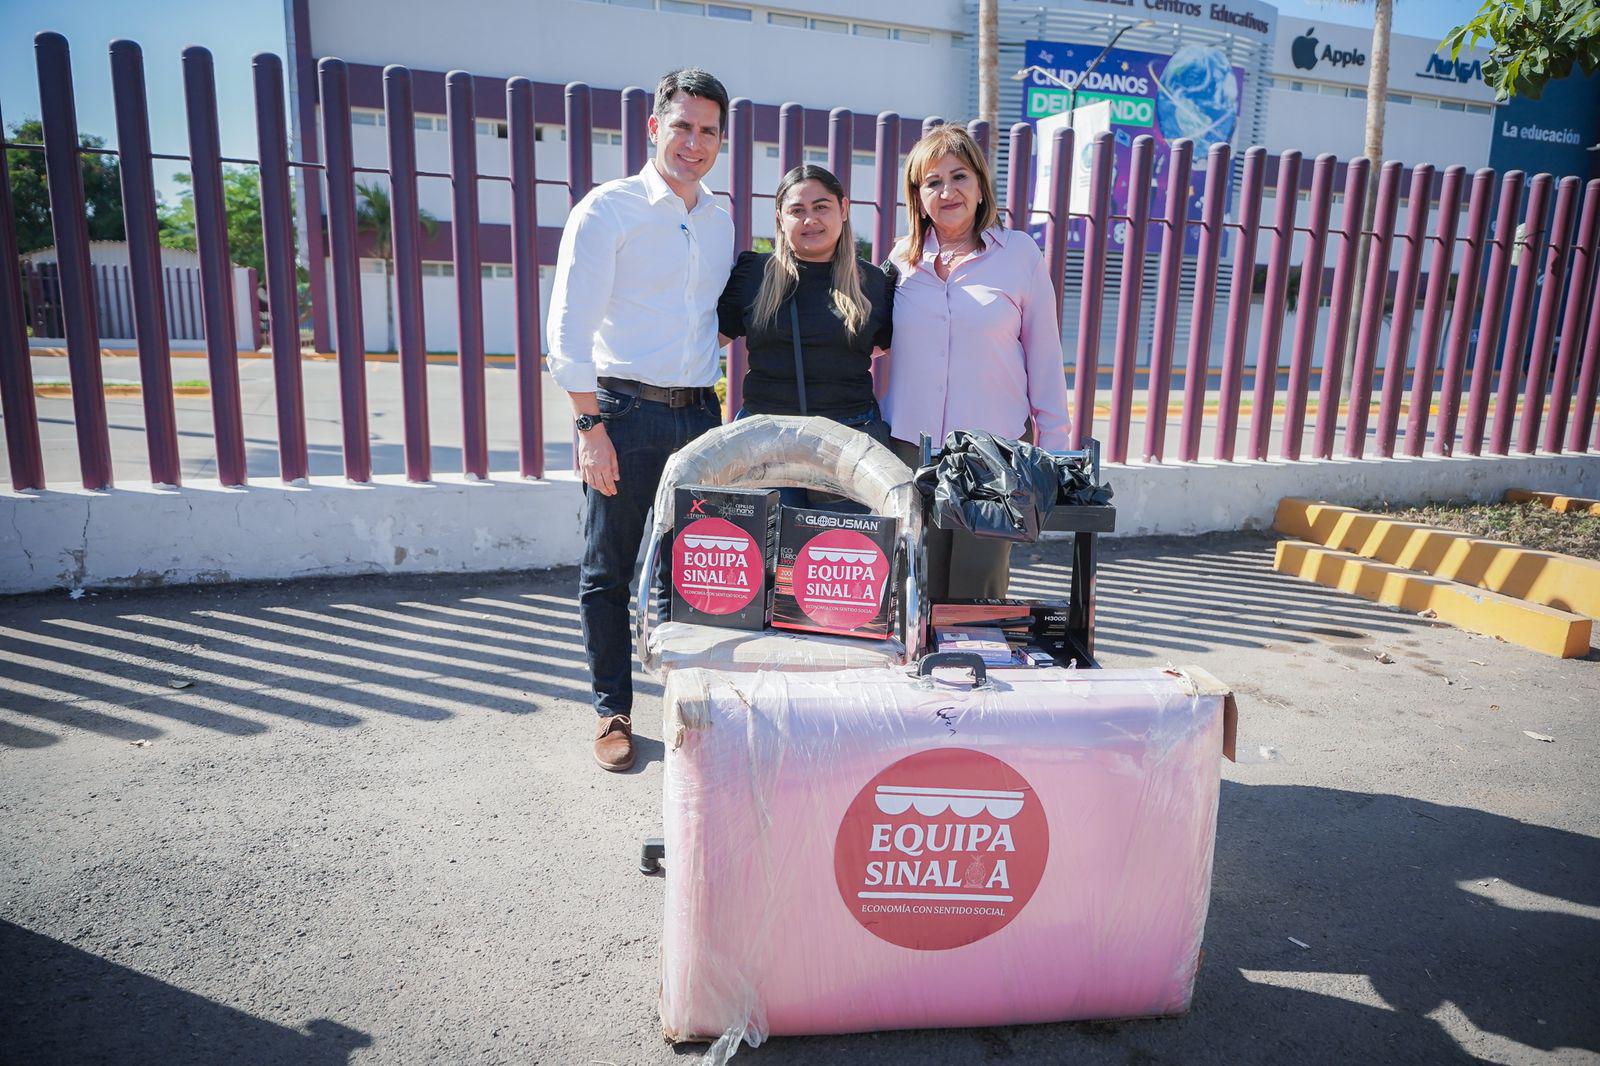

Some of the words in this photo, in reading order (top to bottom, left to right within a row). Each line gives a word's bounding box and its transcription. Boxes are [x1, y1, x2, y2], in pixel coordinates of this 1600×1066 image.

[1144, 0, 1202, 17] Centros
[1210, 3, 1270, 34] Educativos
[1321, 44, 1366, 68] Apple
[1032, 68, 1149, 95] CIUDADANOS
[1076, 96, 1152, 122] MNDO
[1502, 121, 1518, 138] La
[1520, 124, 1581, 145] educación
[805, 515, 879, 531] GLOBUSMAN
[684, 552, 749, 568] EQUIPA
[780, 546, 793, 554] ECO
[807, 565, 875, 582] EQUIPA
[869, 823, 1016, 857] EQUIPA
[861, 903, 911, 914] ECONOMÍA
[912, 905, 933, 914] CON
[933, 906, 973, 915] SENTIDO
[973, 907, 1005, 917] SOCIAL
